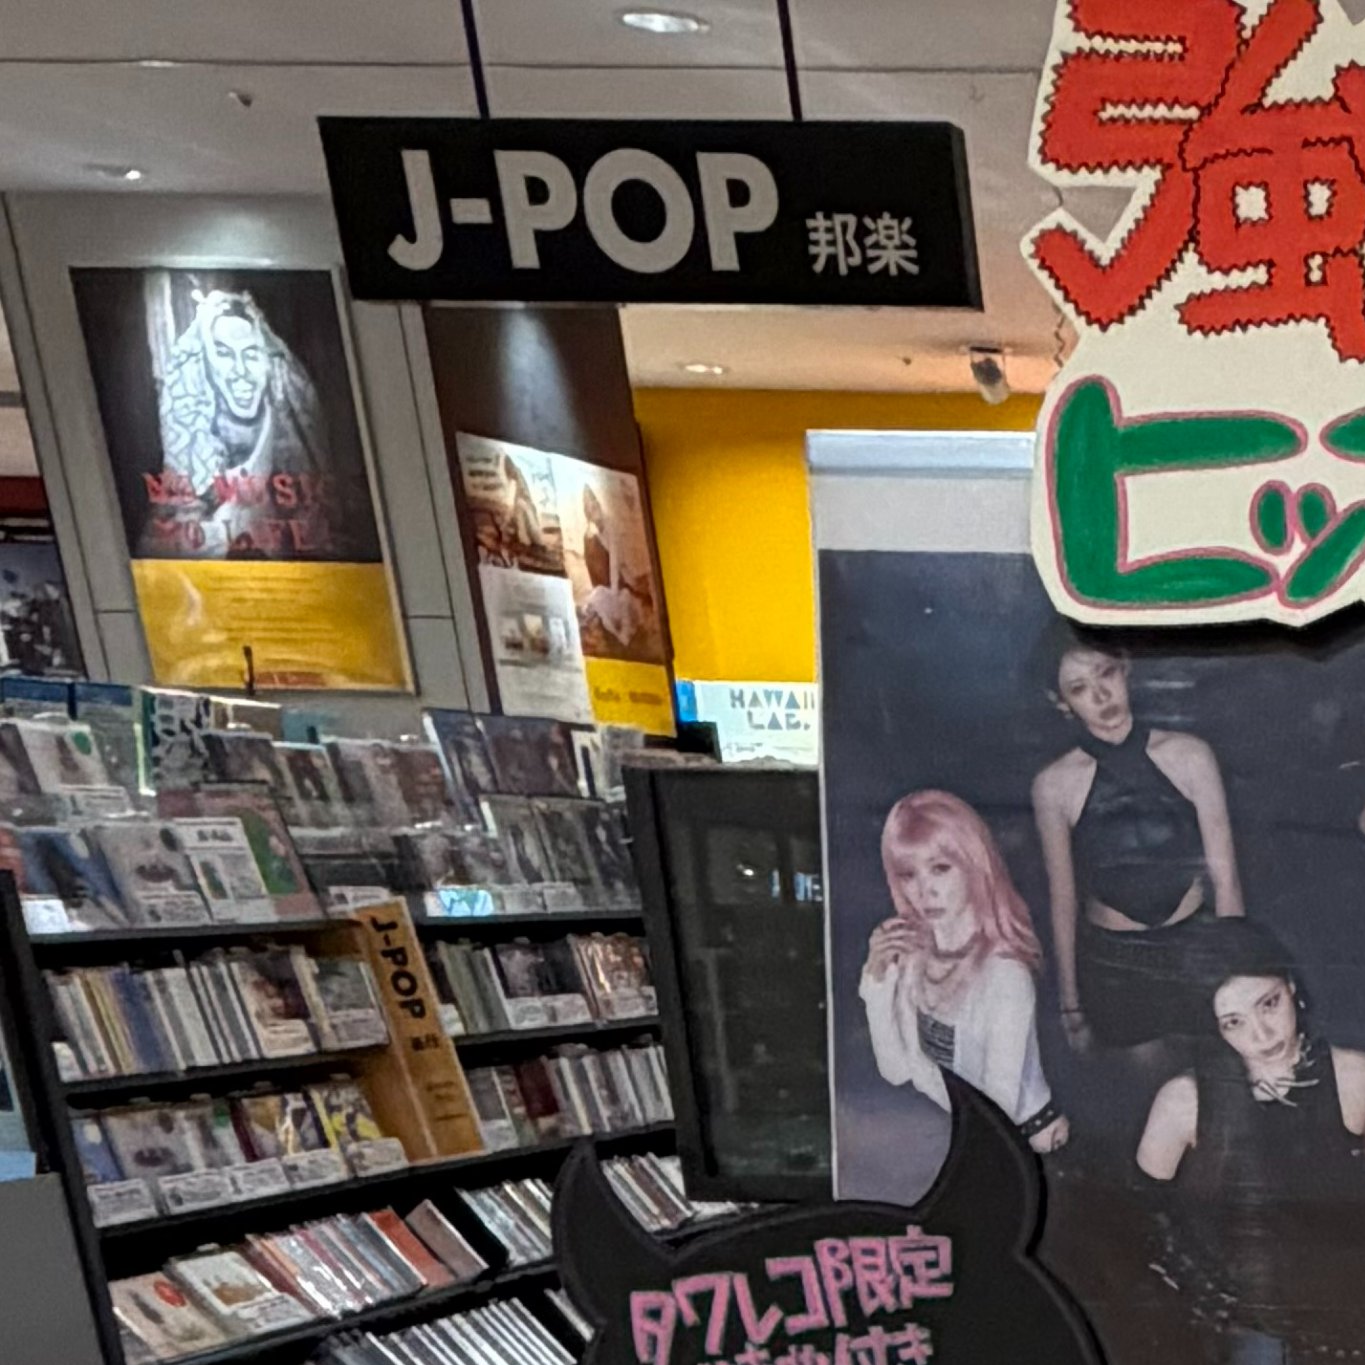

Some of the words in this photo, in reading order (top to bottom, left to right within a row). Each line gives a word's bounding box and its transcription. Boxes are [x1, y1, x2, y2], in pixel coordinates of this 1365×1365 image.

[388, 148, 779, 273] J-POP
[806, 210, 918, 277] 邦楽
[370, 916, 426, 1019] J-POP
